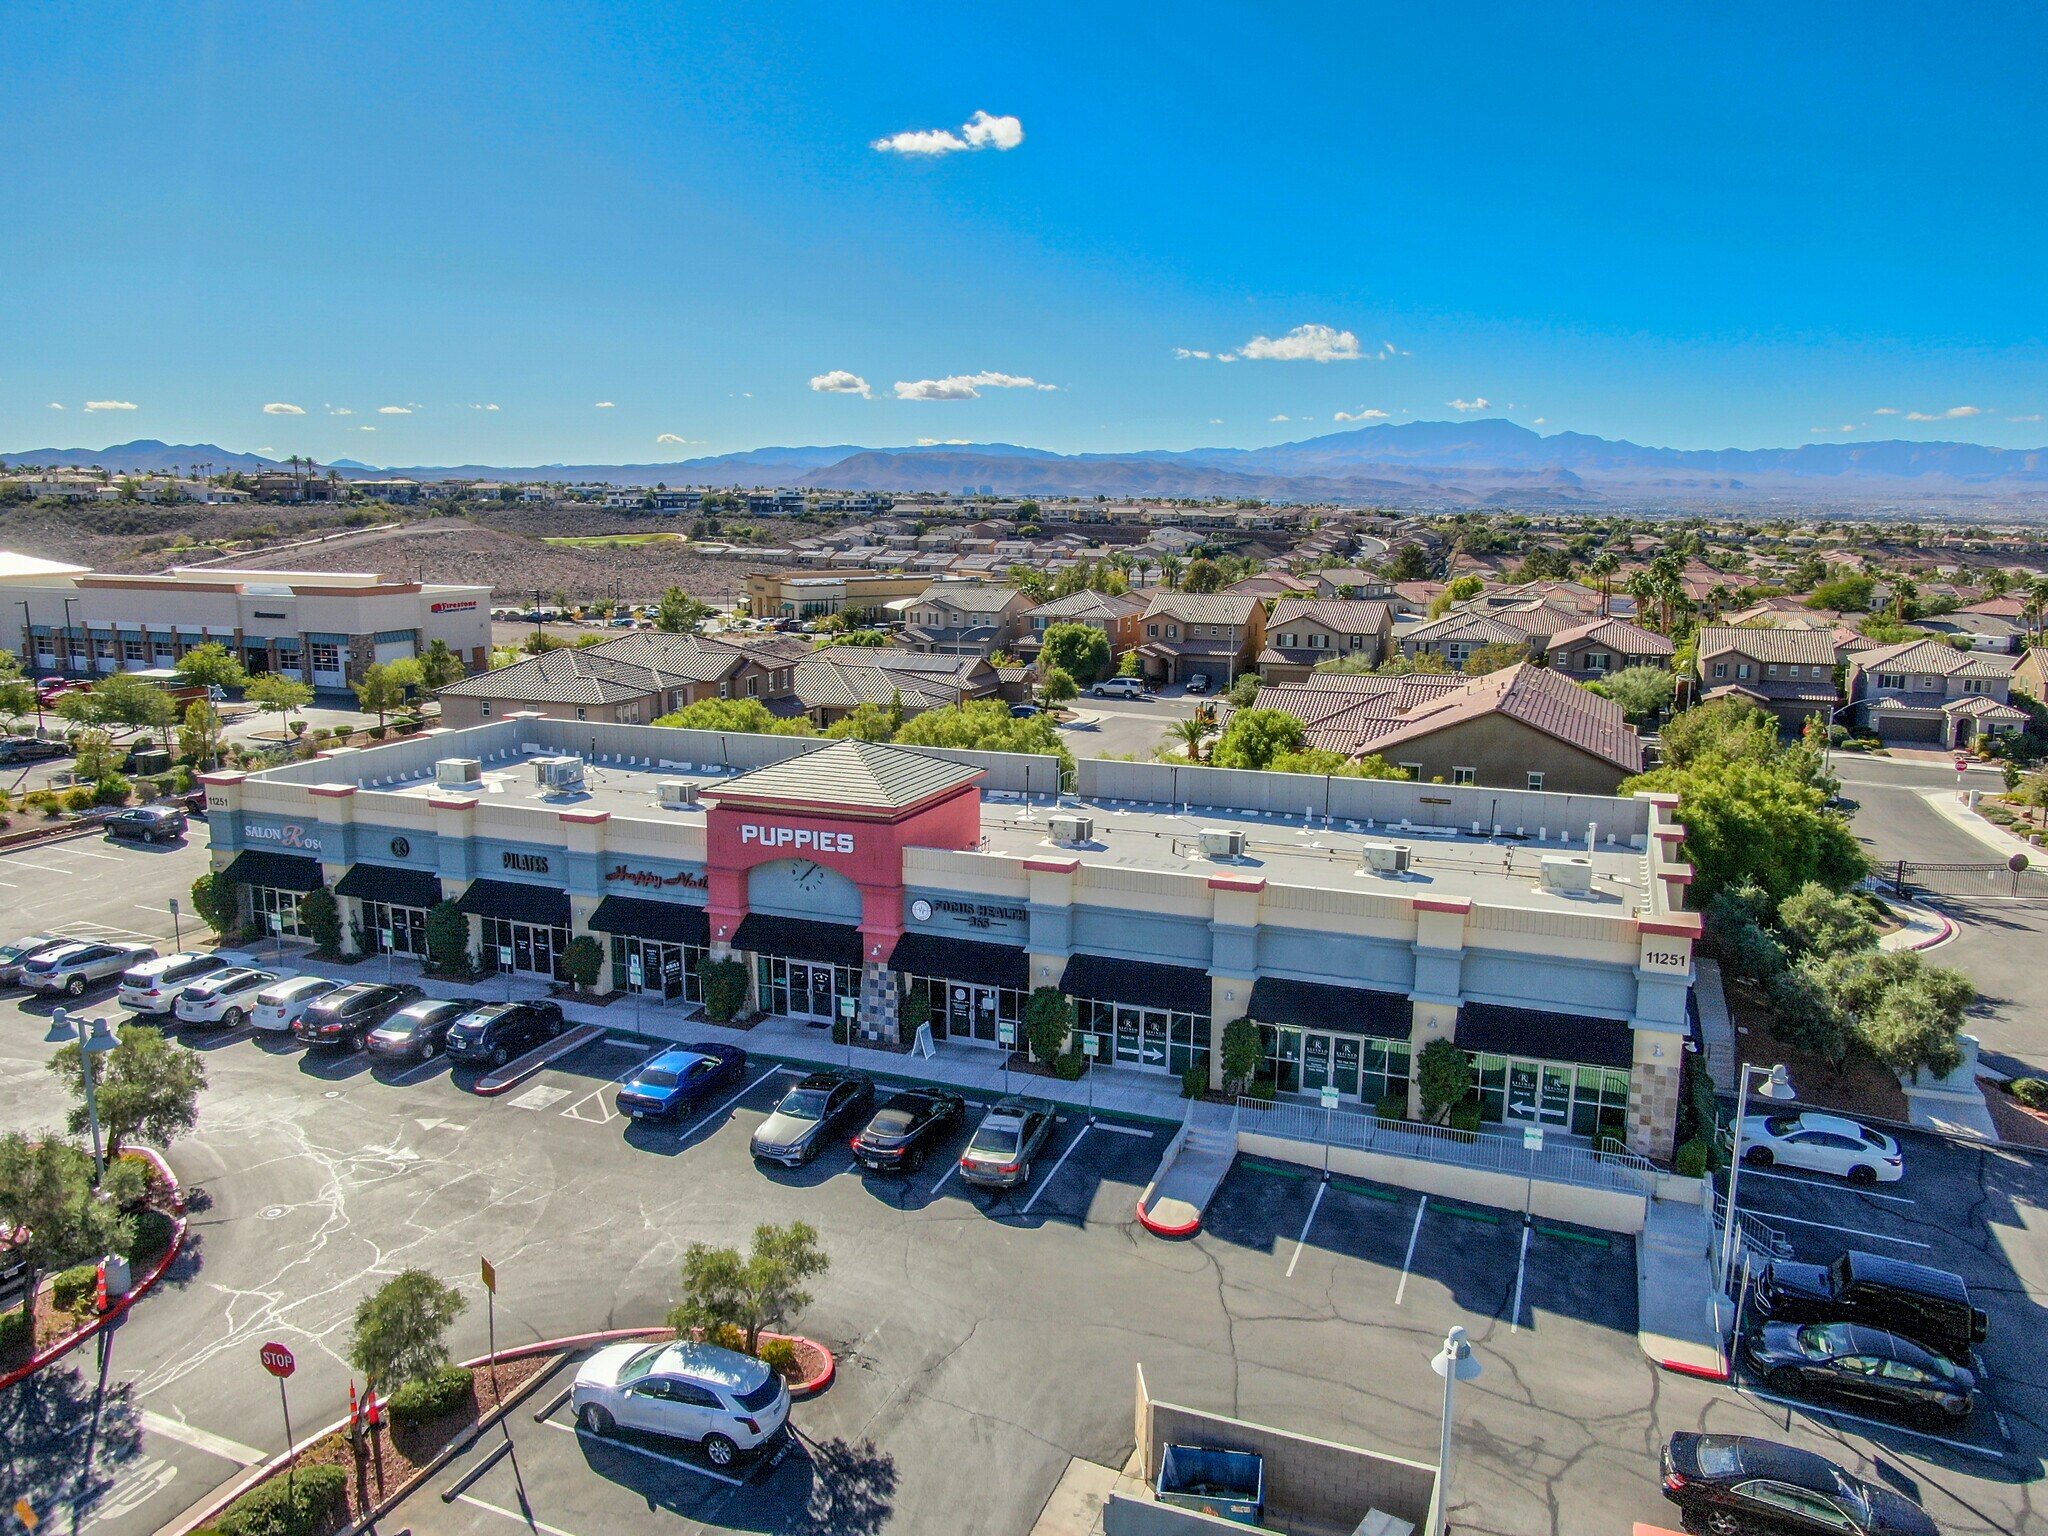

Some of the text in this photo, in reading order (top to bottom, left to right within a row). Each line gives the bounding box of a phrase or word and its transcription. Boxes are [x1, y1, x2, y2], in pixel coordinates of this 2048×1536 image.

[208, 797, 228, 807] 11251
[245, 825, 322, 850] SALON ROS
[741, 824, 854, 854] PUPPIES
[502, 851, 549, 873] PILATES
[605, 864, 662, 889] Happy
[933, 900, 1027, 921] FOCUS HEALTH
[1646, 951, 1686, 967] 11251
[262, 1351, 293, 1368] STOP
